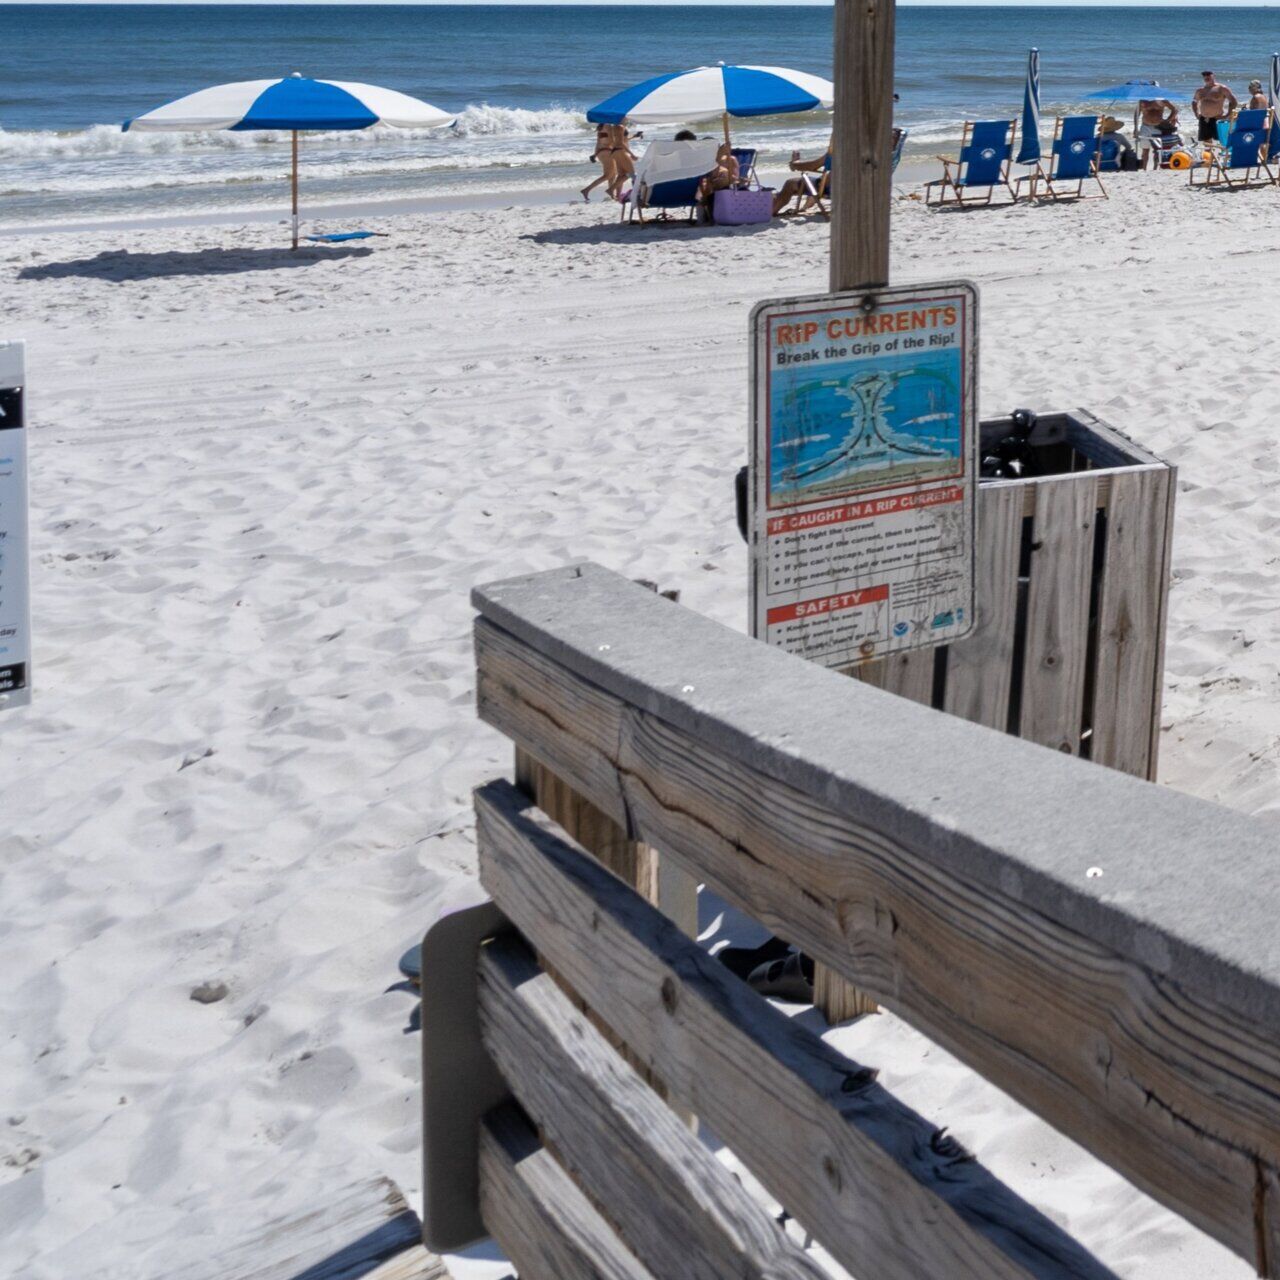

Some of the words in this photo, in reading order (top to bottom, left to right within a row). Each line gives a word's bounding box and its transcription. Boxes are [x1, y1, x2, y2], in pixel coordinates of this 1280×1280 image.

[777, 322, 818, 346] RIP
[827, 306, 956, 339] CURRENTS
[777, 349, 819, 364] Break
[825, 346, 847, 358] the
[852, 342, 880, 356] Grip
[885, 339, 899, 351] of
[904, 337, 924, 348] the
[929, 332, 955, 346] Rip!
[773, 520, 786, 531] IF
[791, 509, 844, 528] CAUGHT
[848, 505, 861, 517] IN
[865, 502, 873, 514] A
[876, 498, 897, 511] RIP
[900, 489, 958, 507] CURRENT
[785, 534, 806, 543] Don't
[808, 530, 828, 541] fight
[829, 527, 842, 537] the
[845, 521, 874, 532] current
[785, 548, 807, 557] Swim
[810, 545, 823, 554] out
[836, 539, 849, 547] the
[885, 529, 902, 537] then
[915, 523, 936, 532] shore
[794, 562, 808, 570] you
[866, 546, 884, 555] float
[897, 540, 917, 548] tread
[794, 575, 808, 583] you
[854, 562, 868, 570] call
[881, 556, 901, 564] wave
[795, 592, 863, 616] SAFETY
[787, 623, 809, 632] Know
[787, 634, 810, 644] Never
[813, 629, 834, 637] swim
